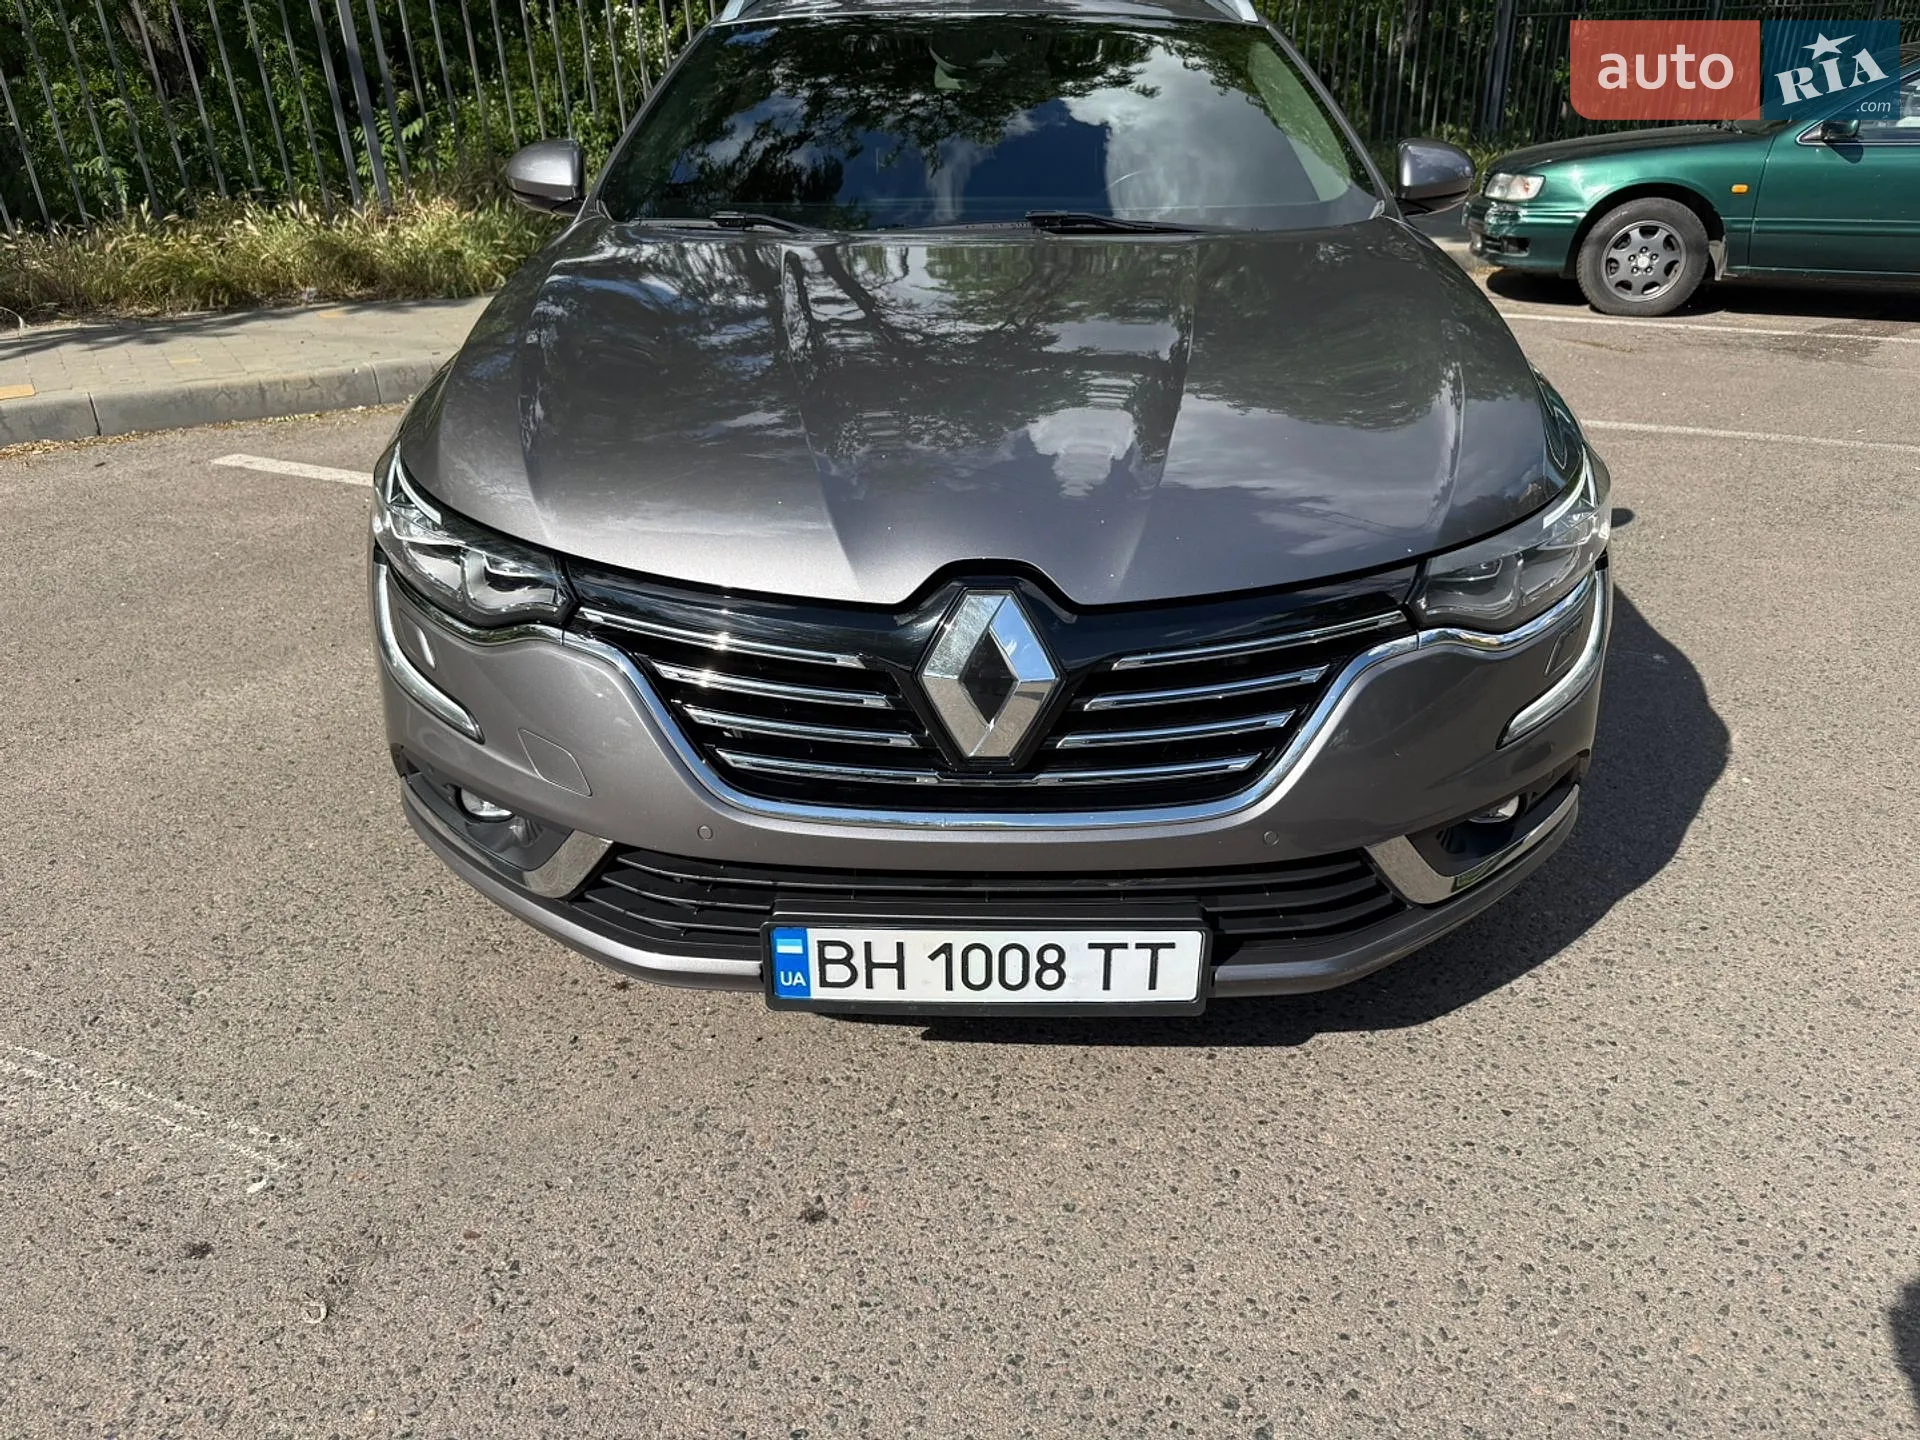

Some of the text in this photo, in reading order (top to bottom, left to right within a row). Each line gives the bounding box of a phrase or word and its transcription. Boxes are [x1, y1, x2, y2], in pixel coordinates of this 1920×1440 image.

[780, 971, 807, 987] UA
[816, 939, 1176, 992] BH 1008 TT
